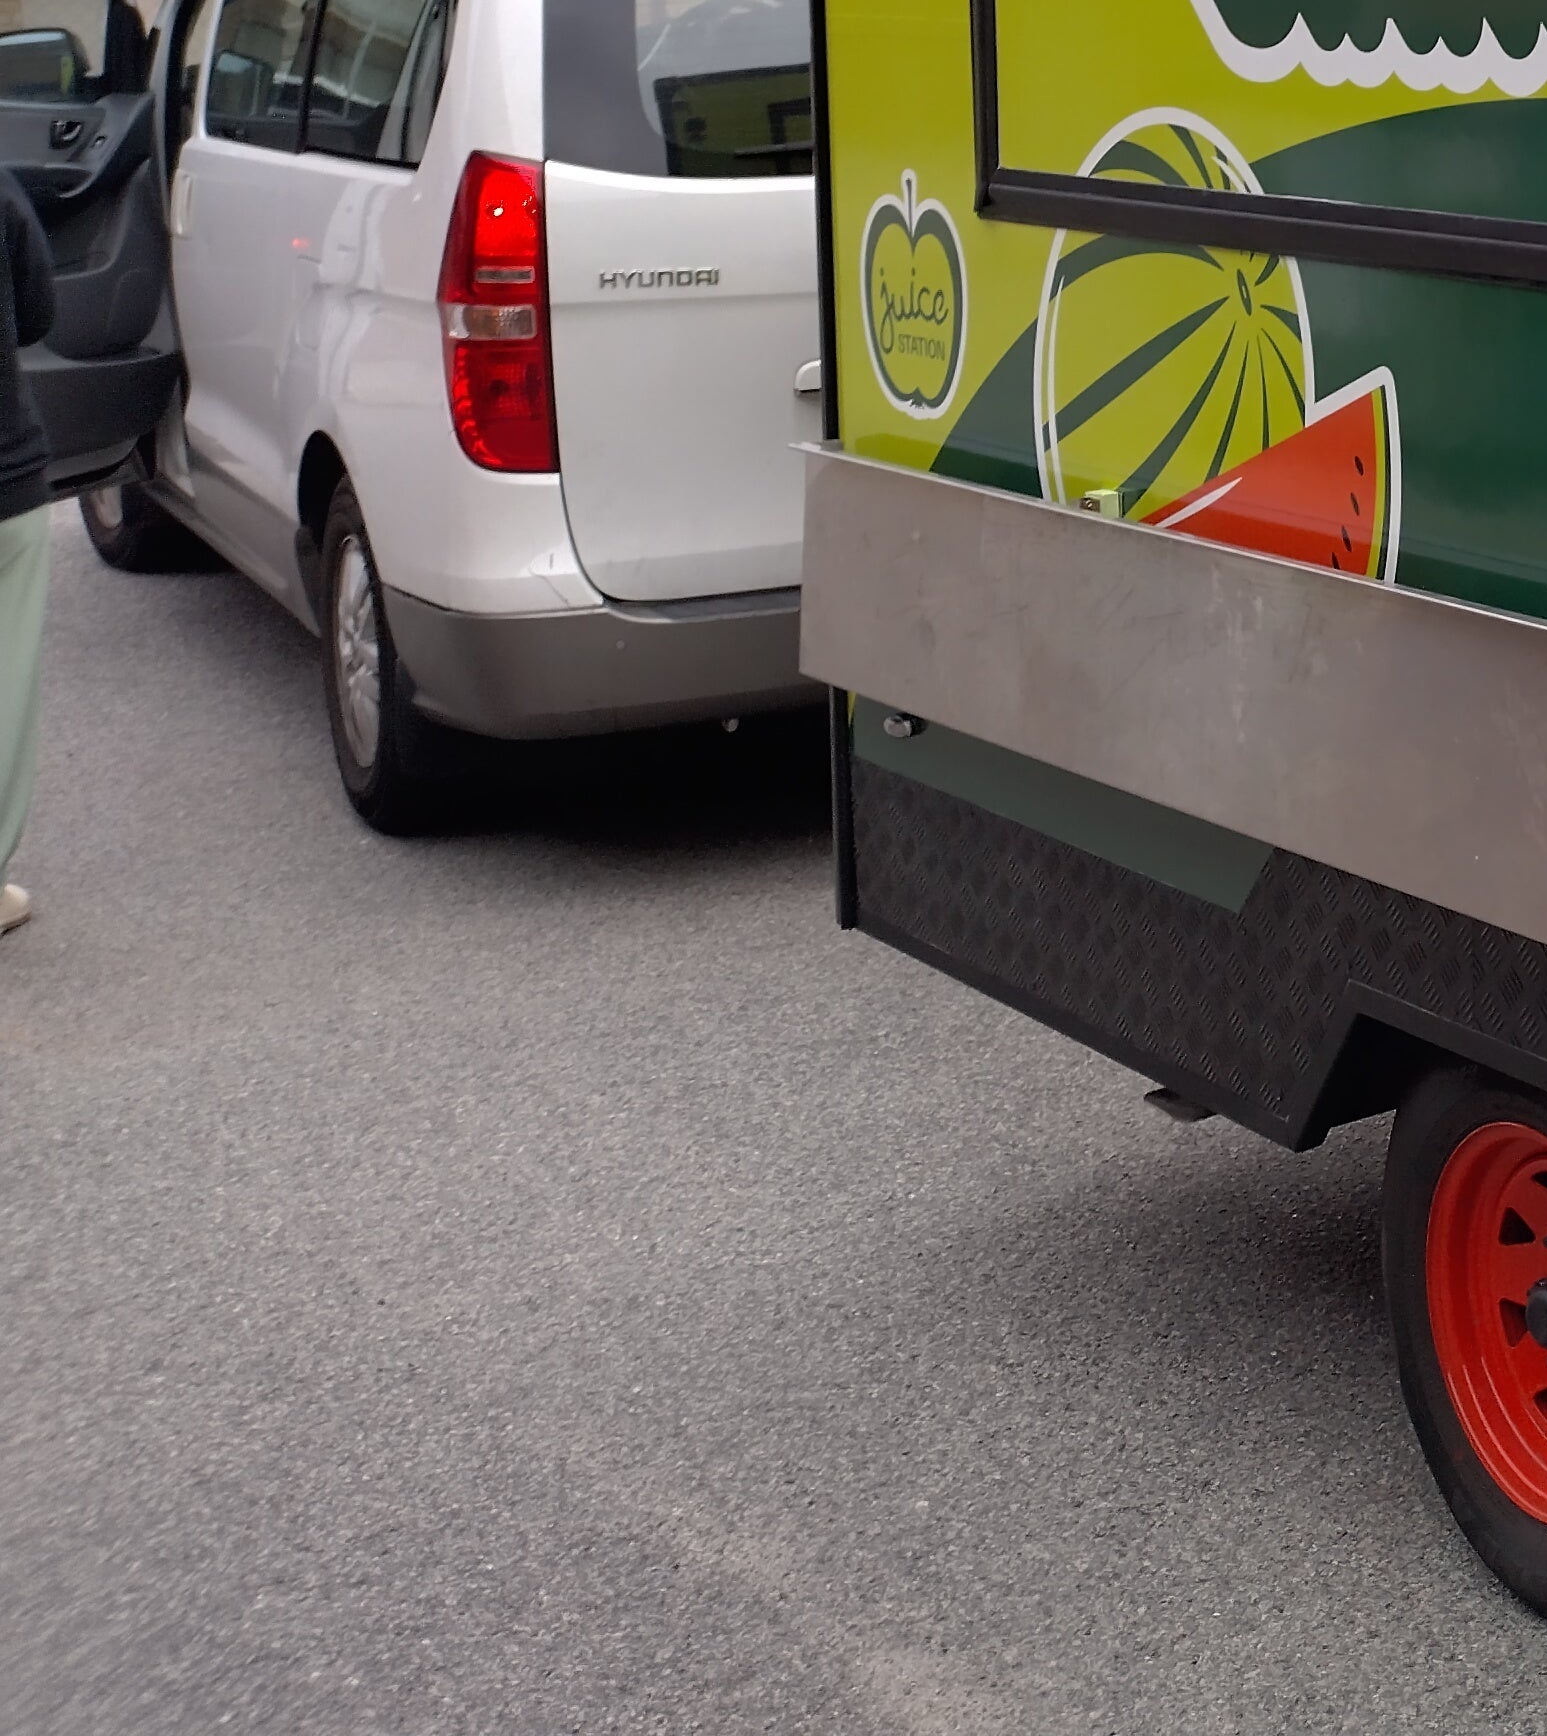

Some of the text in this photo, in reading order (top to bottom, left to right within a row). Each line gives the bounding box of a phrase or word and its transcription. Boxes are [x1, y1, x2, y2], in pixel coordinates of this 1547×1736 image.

[599, 267, 719, 289] HYUNDAI
[880, 267, 949, 355] juice
[898, 332, 946, 361] STATION
